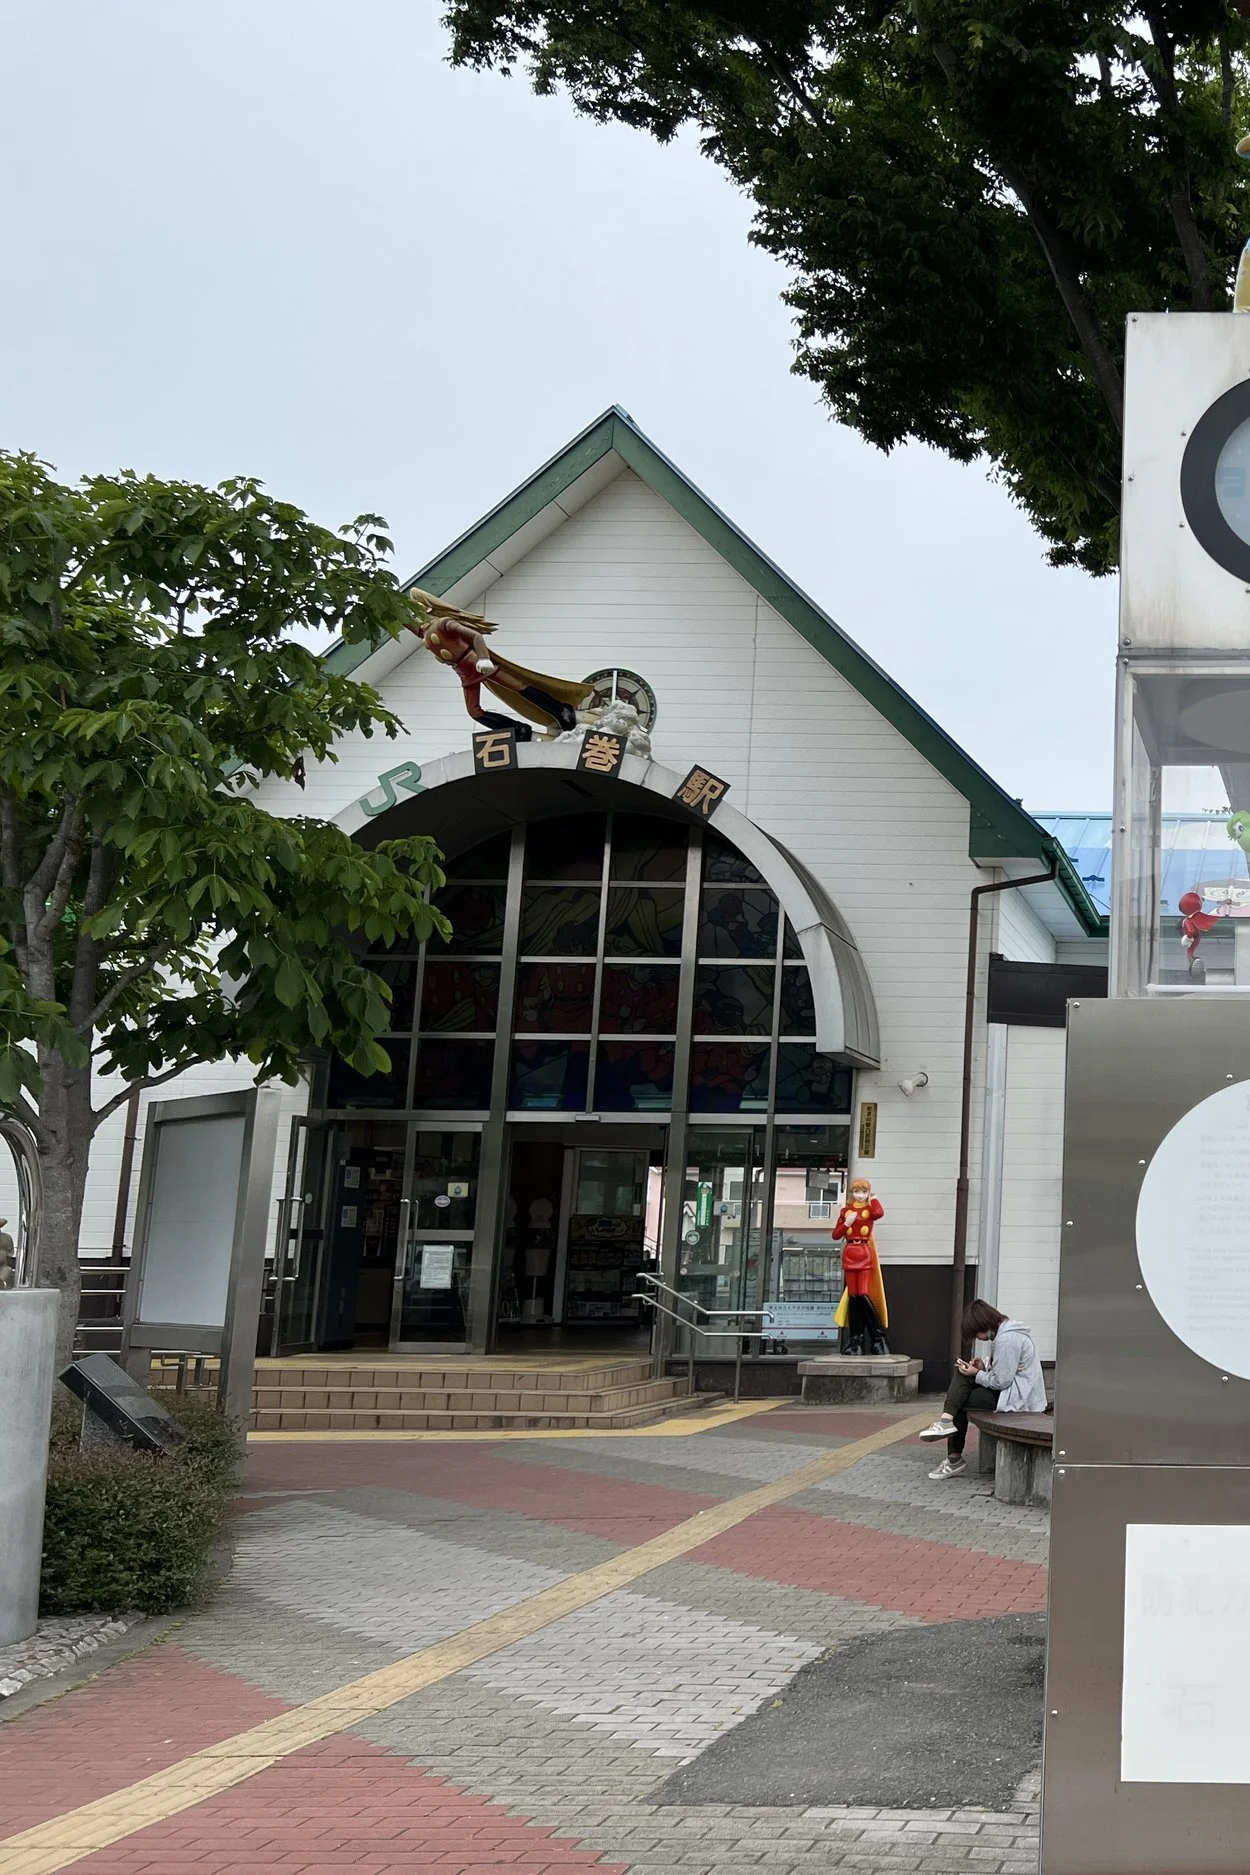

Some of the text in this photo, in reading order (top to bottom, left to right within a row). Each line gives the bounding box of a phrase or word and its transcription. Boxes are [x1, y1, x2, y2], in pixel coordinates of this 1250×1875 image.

[359, 731, 726, 817] JR 石巻駅
